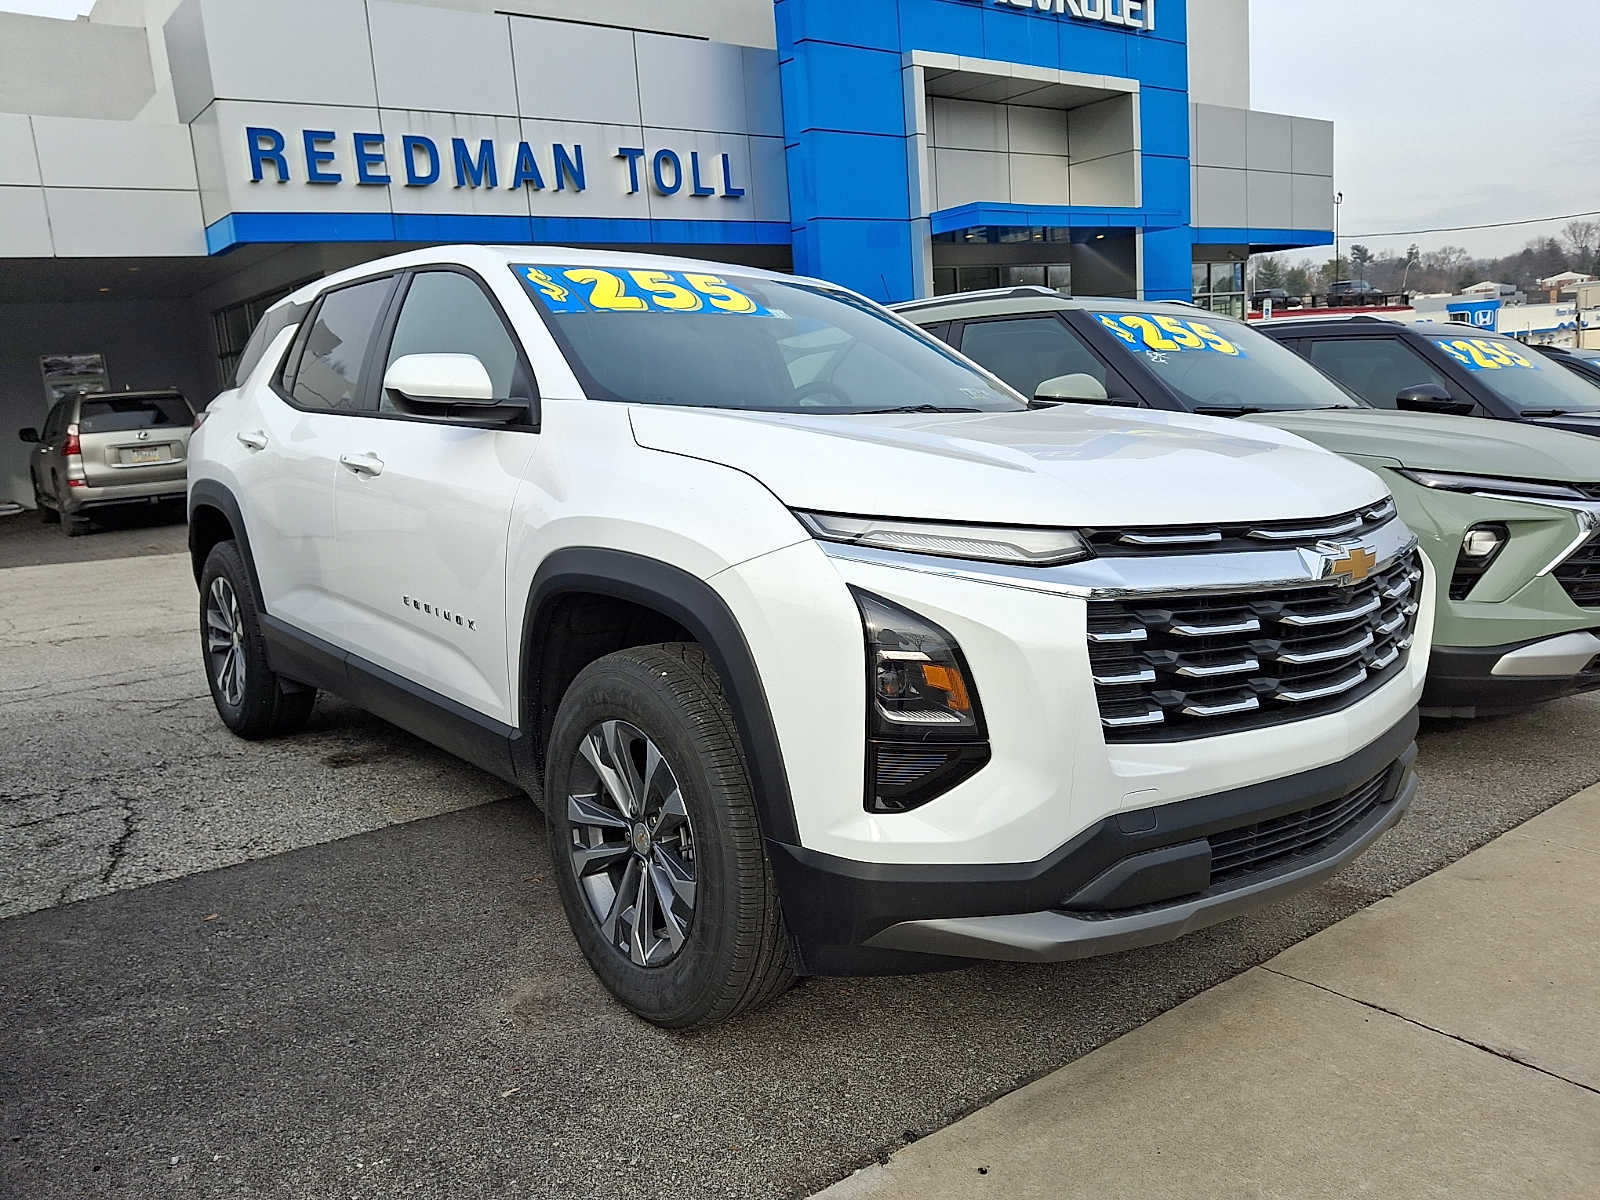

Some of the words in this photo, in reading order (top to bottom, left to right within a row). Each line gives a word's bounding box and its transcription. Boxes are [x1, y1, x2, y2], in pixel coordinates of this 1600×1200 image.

[245, 126, 587, 191] REEDMAN
[617, 147, 745, 197] TOLL
[526, 266, 758, 314] $255
[1099, 314, 1240, 356] $255
[1438, 339, 1534, 369] $255
[403, 595, 476, 632] EQUINOX
